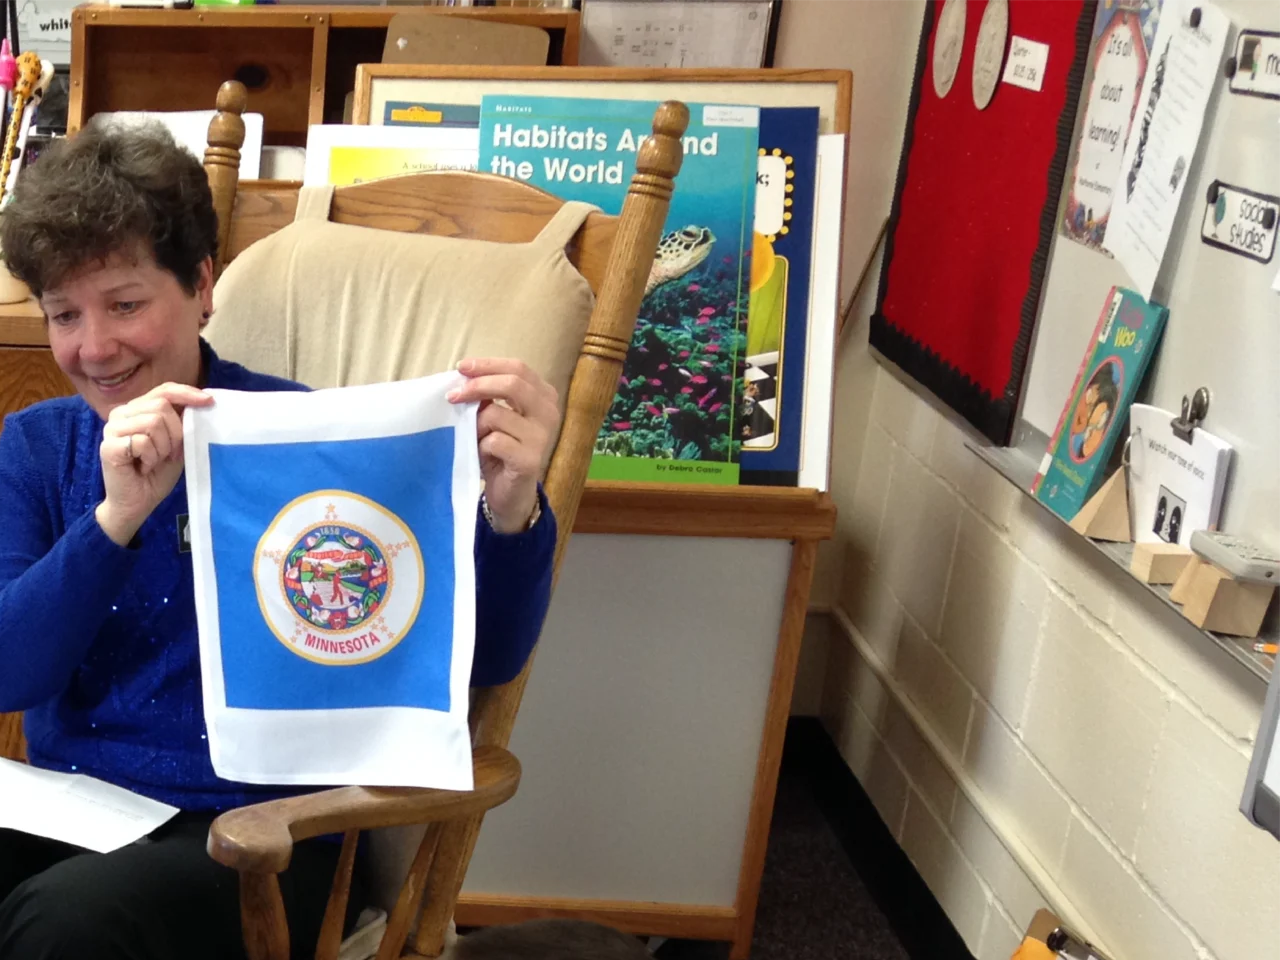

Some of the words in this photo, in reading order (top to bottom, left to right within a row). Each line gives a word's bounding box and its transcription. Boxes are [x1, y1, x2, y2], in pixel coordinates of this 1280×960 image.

[493, 123, 608, 152] Habitats
[490, 155, 533, 180] the
[543, 157, 624, 184] World
[1230, 223, 1266, 253] studies
[1114, 326, 1136, 348] Woo
[656, 464, 667, 472] by
[669, 464, 694, 473] Debra
[304, 631, 381, 654] MINNESOTA
